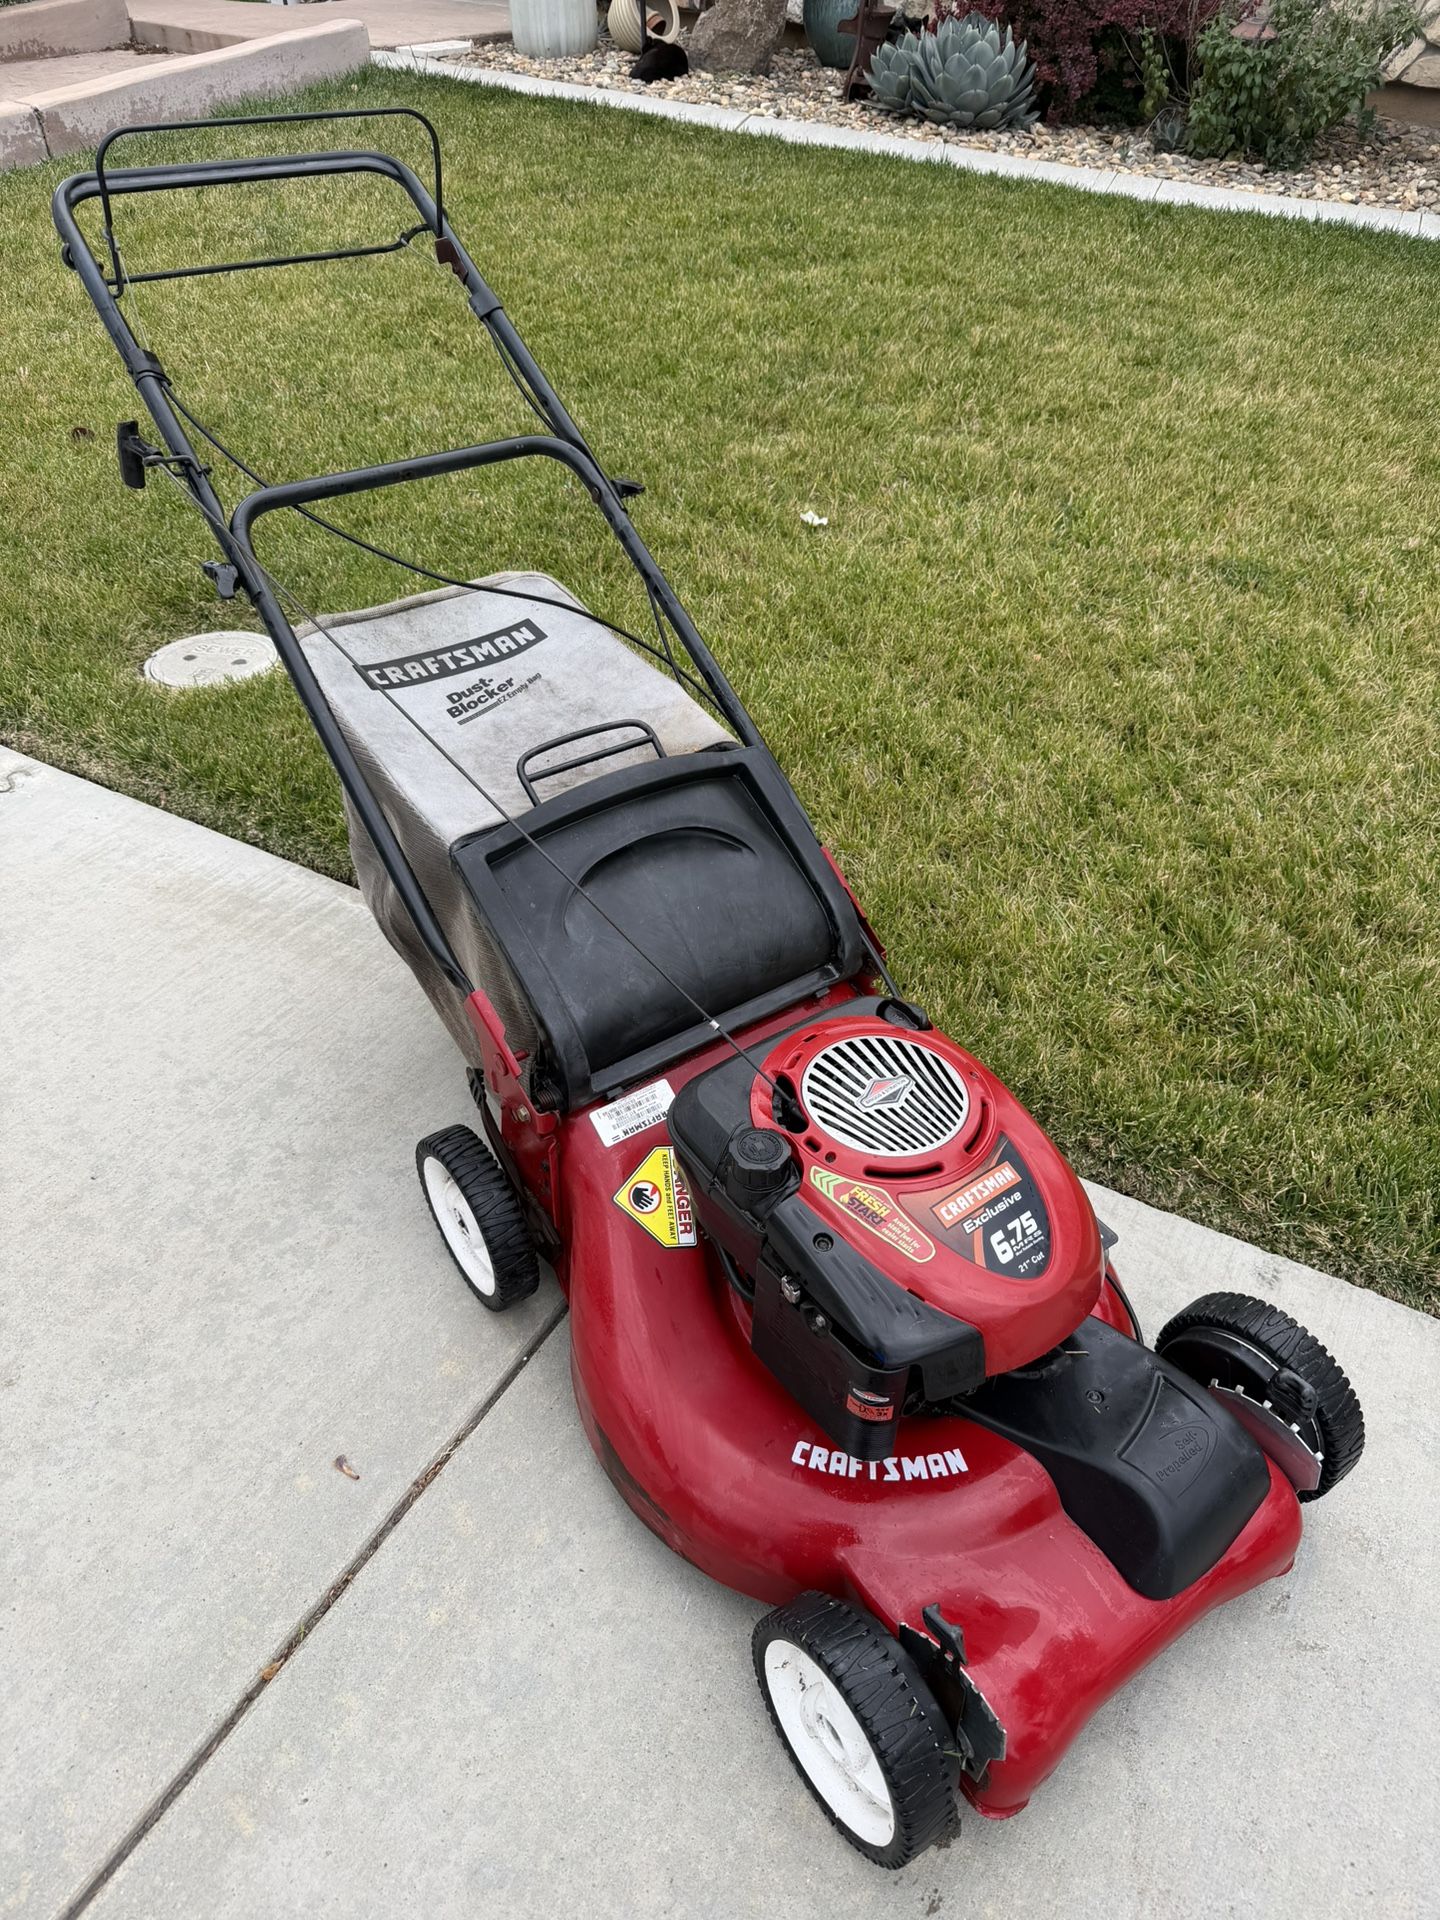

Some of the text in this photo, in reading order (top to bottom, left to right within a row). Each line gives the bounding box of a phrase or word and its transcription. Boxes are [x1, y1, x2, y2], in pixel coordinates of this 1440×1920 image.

[193, 643, 257, 656] SEWER
[367, 626, 536, 686] CRAFTSMAN
[446, 678, 494, 704] Dust-
[446, 677, 514, 718] Blocker
[506, 683, 529, 698] Empty
[622, 1109, 669, 1136] RAFTSMAN
[849, 1185, 891, 1217] FRESH
[940, 1166, 1015, 1221] CRAFTSMAN
[848, 1197, 887, 1226] START
[962, 1190, 1022, 1234] Exclusive
[990, 1210, 1038, 1264] 6.75
[1031, 1251, 1045, 1263] Cut
[791, 1440, 969, 1481] CRAFTSMAN
[1155, 1444, 1203, 1482] Propelled
